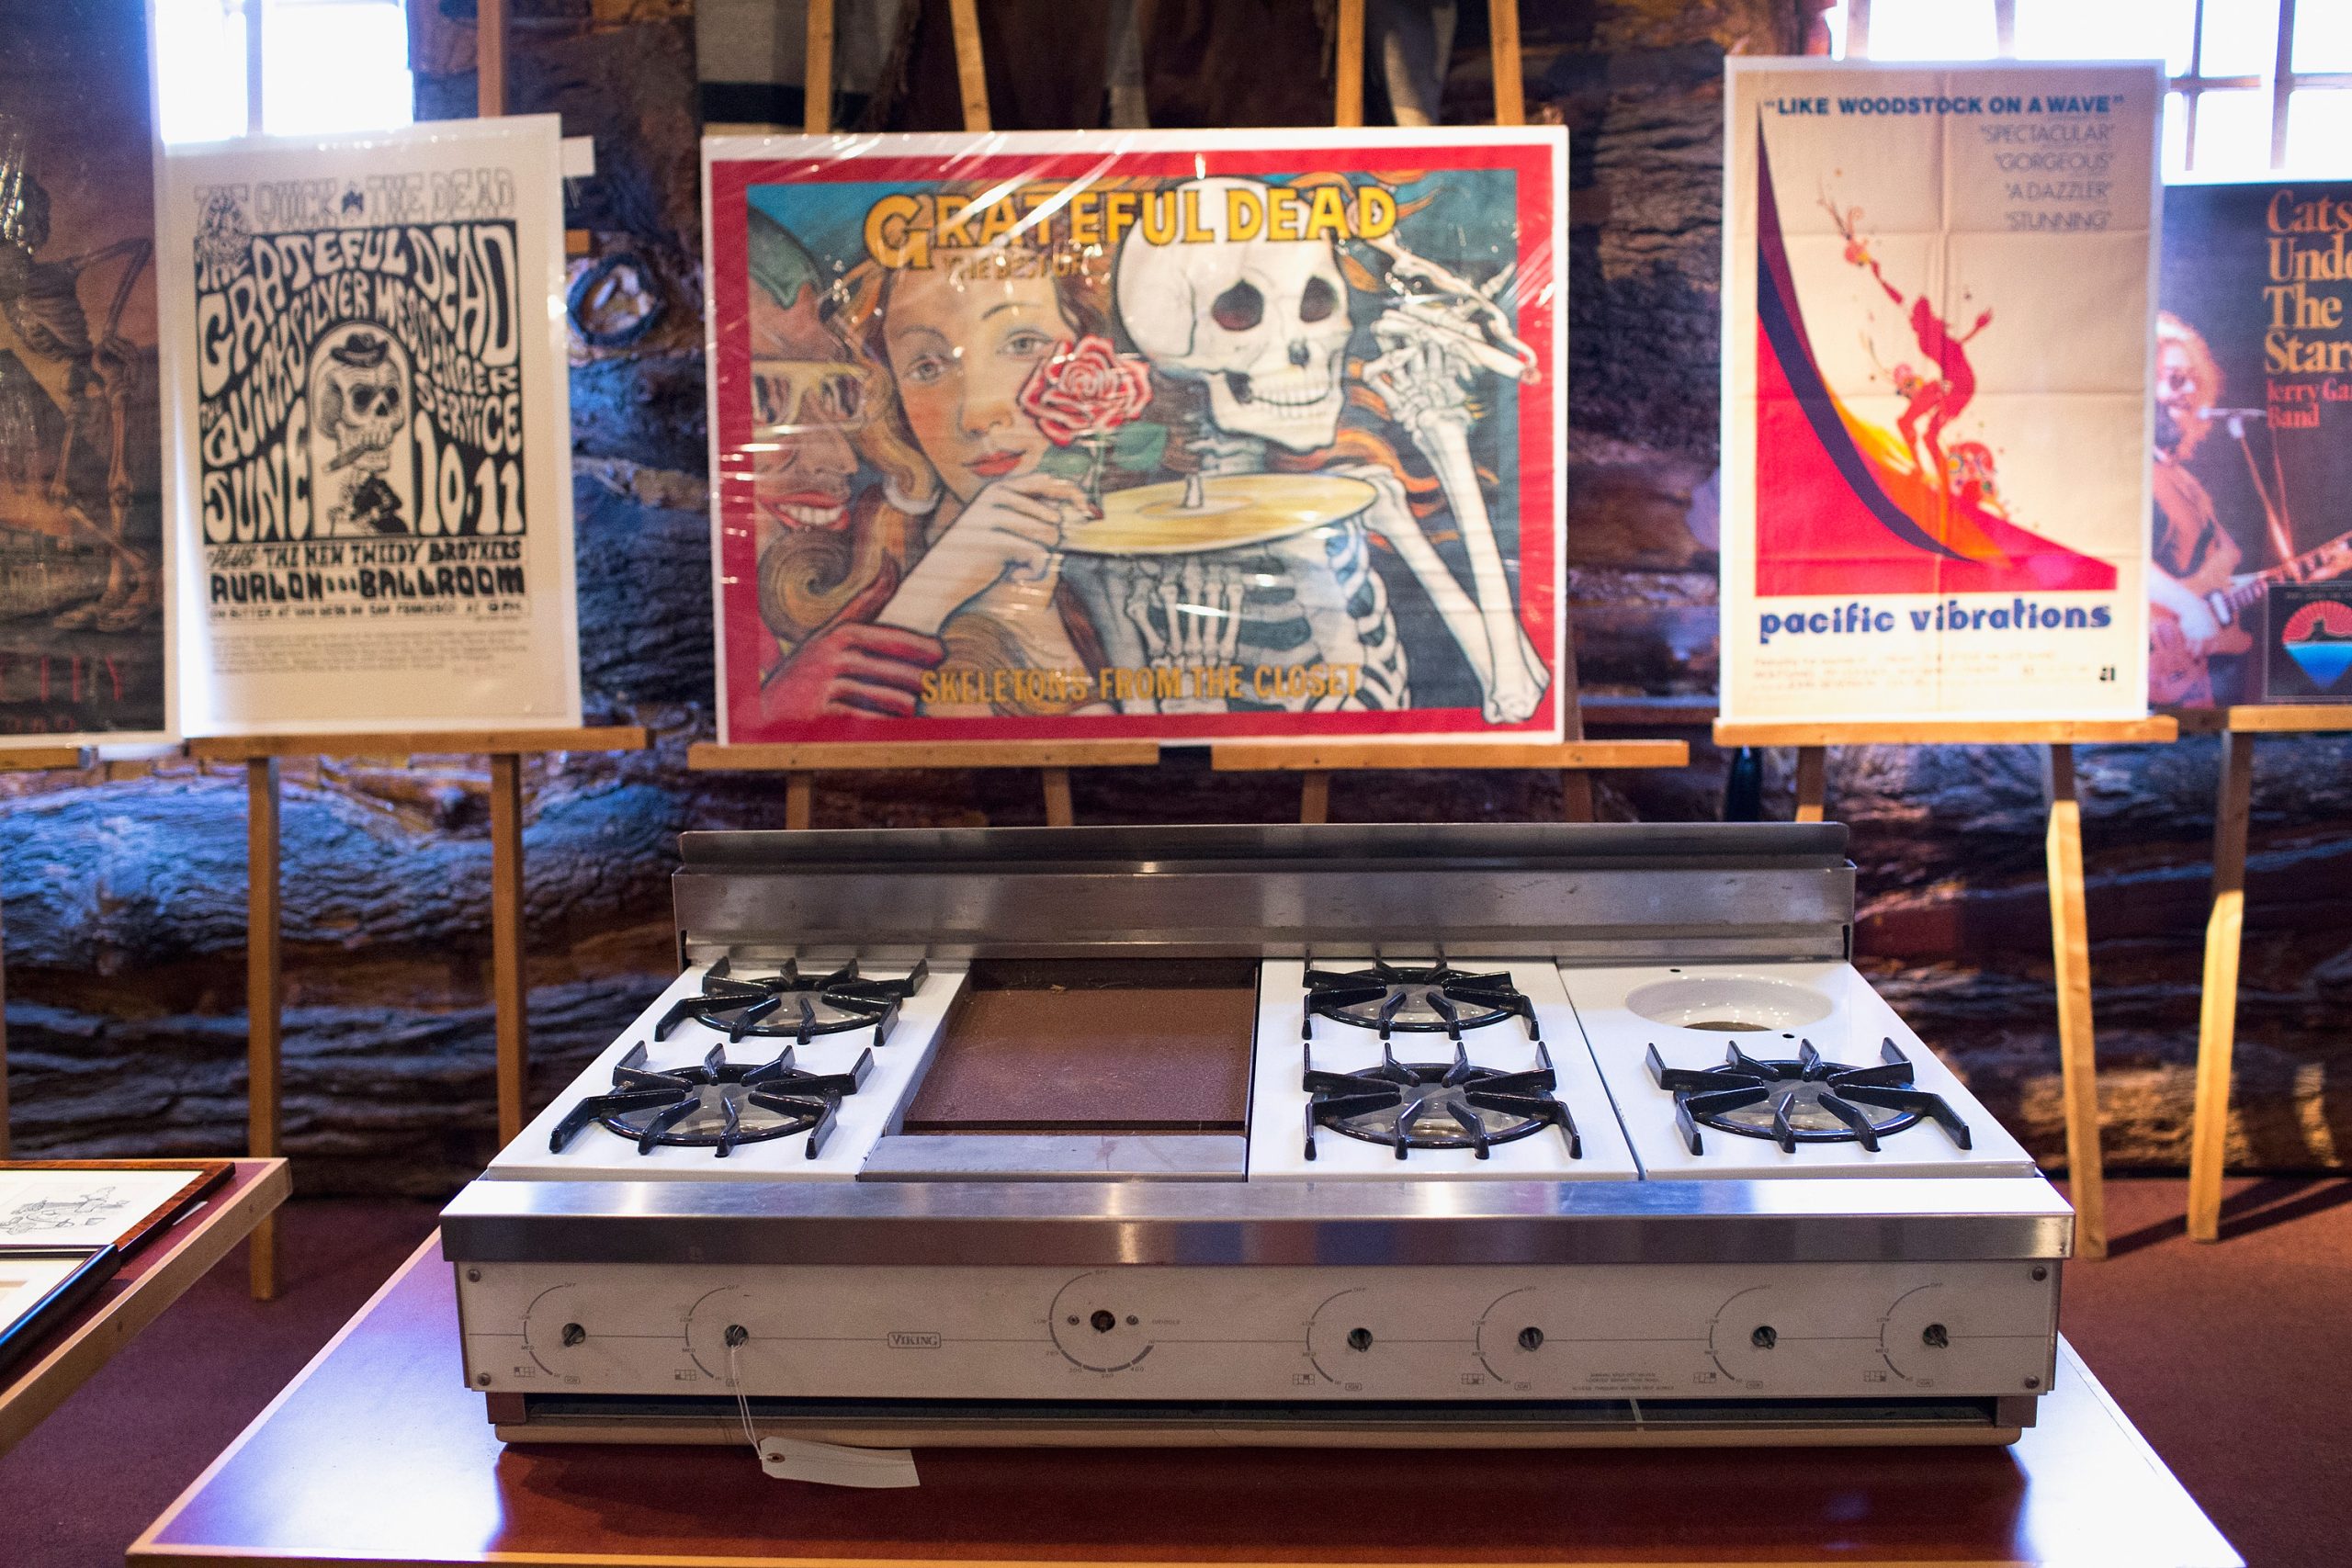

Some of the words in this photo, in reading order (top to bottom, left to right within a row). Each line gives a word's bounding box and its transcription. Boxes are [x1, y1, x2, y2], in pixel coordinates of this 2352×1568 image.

[1838, 96, 1983, 116] WOODSTOCK
[1989, 96, 2021, 114] ON
[2028, 96, 2042, 113] A
[864, 188, 1216, 271] GRATEFUL
[1226, 186, 1399, 243] DEAD
[2267, 189, 2352, 233] Cats
[198, 228, 407, 398] GRATEFUL
[406, 224, 518, 367] DEAD
[2263, 281, 2343, 330] The
[2267, 401, 2320, 429] Band
[359, 565, 525, 600] BALLROOM
[1759, 602, 1895, 645] pacific
[1910, 599, 2112, 633] vibrations
[921, 663, 1089, 705] SKELETONS
[1101, 664, 1182, 701] FROM
[1192, 664, 1243, 699] THE
[1254, 662, 1361, 699] CLOSET
[892, 1334, 938, 1347] VIKING
